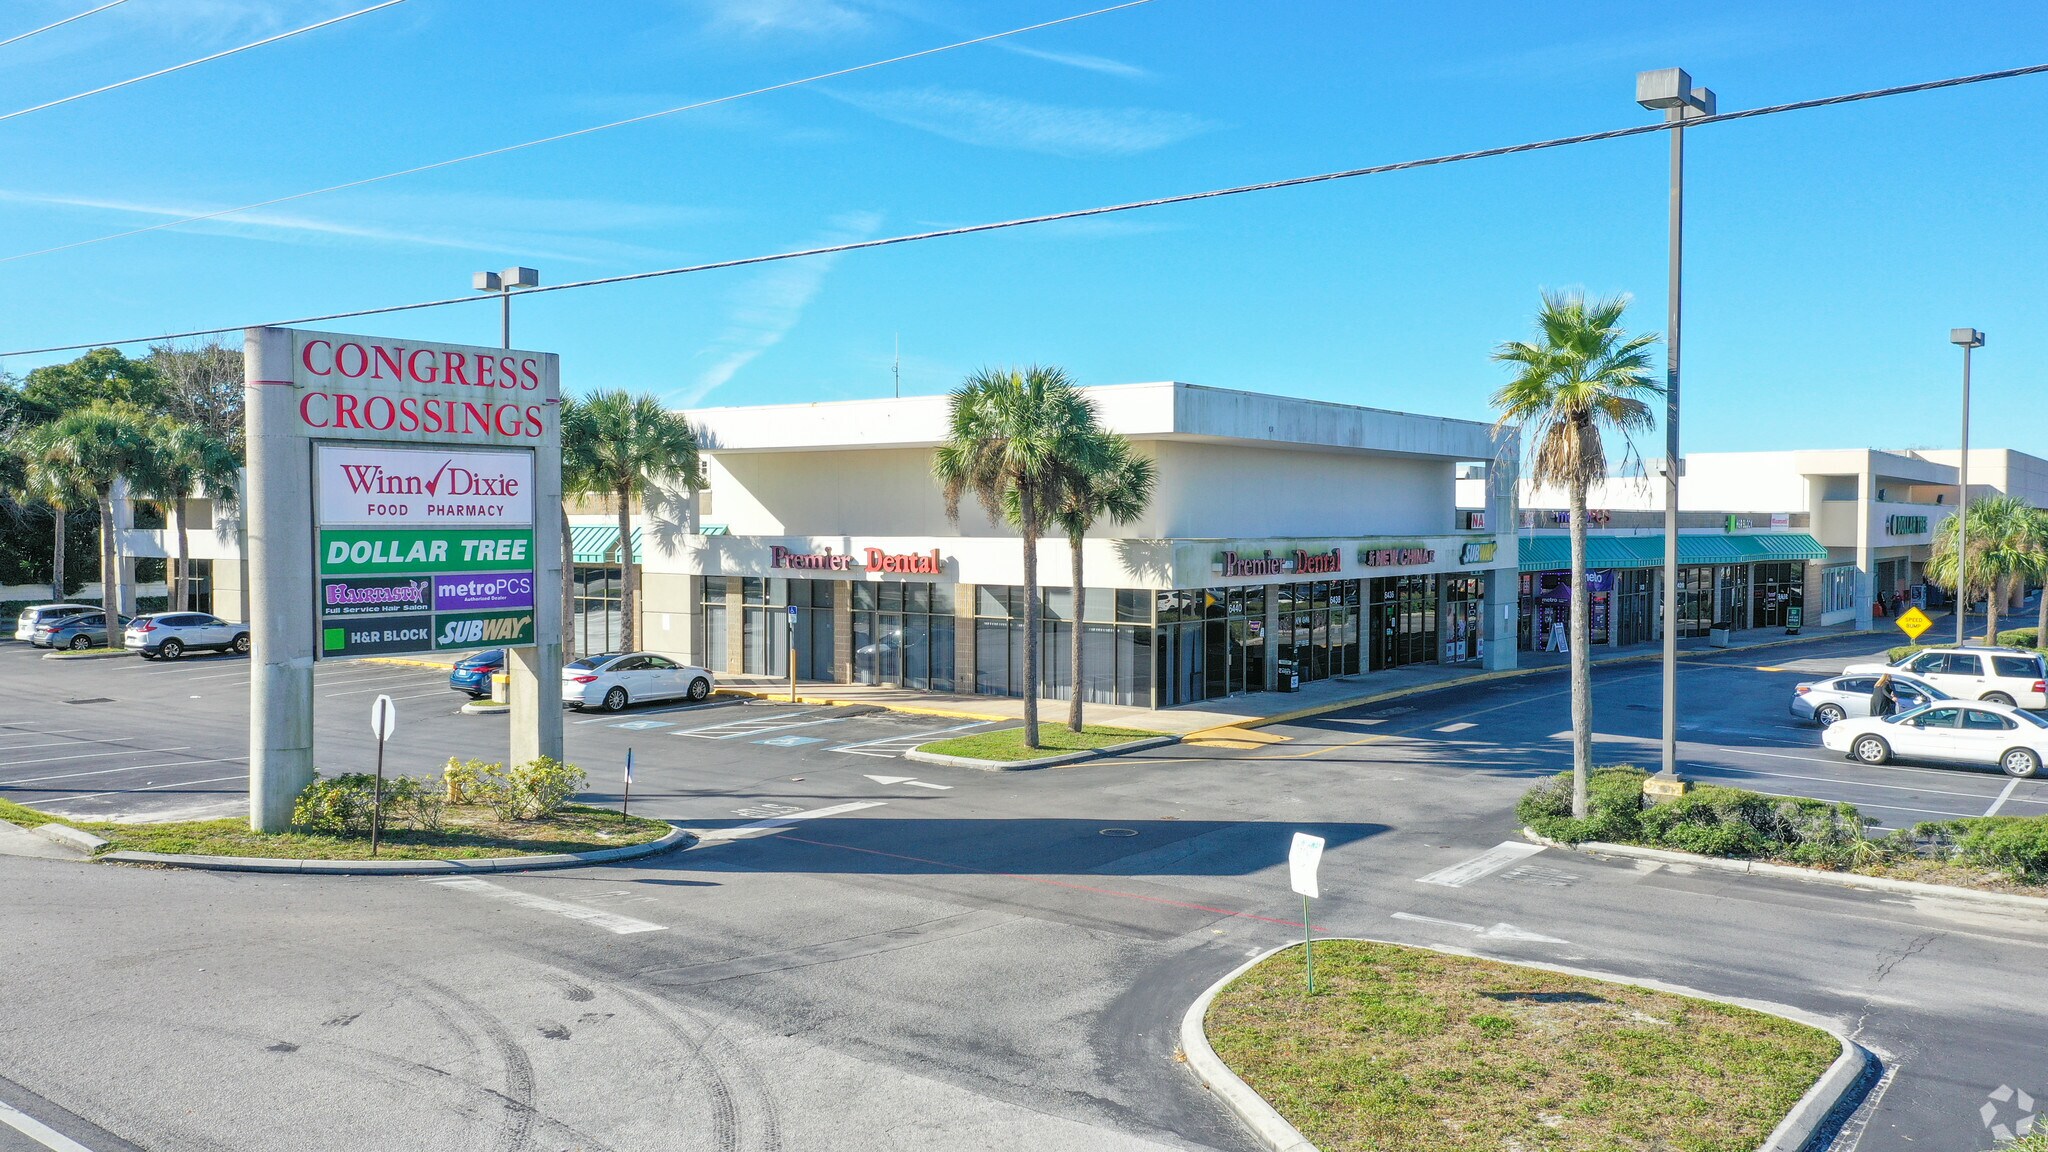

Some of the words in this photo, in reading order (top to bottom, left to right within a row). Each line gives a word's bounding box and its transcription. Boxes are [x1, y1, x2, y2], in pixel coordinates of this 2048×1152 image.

[302, 339, 539, 390] CONGRESS
[299, 392, 543, 437] CROSSINGS
[340, 464, 423, 494] Winn
[447, 467, 519, 497] Dixie
[368, 504, 408, 516] FOOD
[427, 504, 504, 517] PHARMACY
[326, 540, 449, 564] DOLLAR
[460, 539, 527, 562] TREE
[770, 545, 852, 572] Premier
[864, 547, 941, 574] Dental
[1225, 550, 1286, 577] Premier
[1295, 548, 1342, 575] Dental
[1376, 549, 1399, 567] NEW
[1399, 548, 1429, 566] CHINA
[1463, 542, 1497, 563] SUBWAY
[438, 578, 530, 598] metroPCS
[325, 606, 342, 614] Full
[343, 605, 380, 613] Service
[381, 604, 401, 612] Hair
[403, 603, 428, 611] Salon
[1228, 603, 1243, 613] 6440
[351, 630, 380, 643] H&R
[383, 628, 428, 641] BLOCK
[438, 615, 531, 645] SUBWAY
